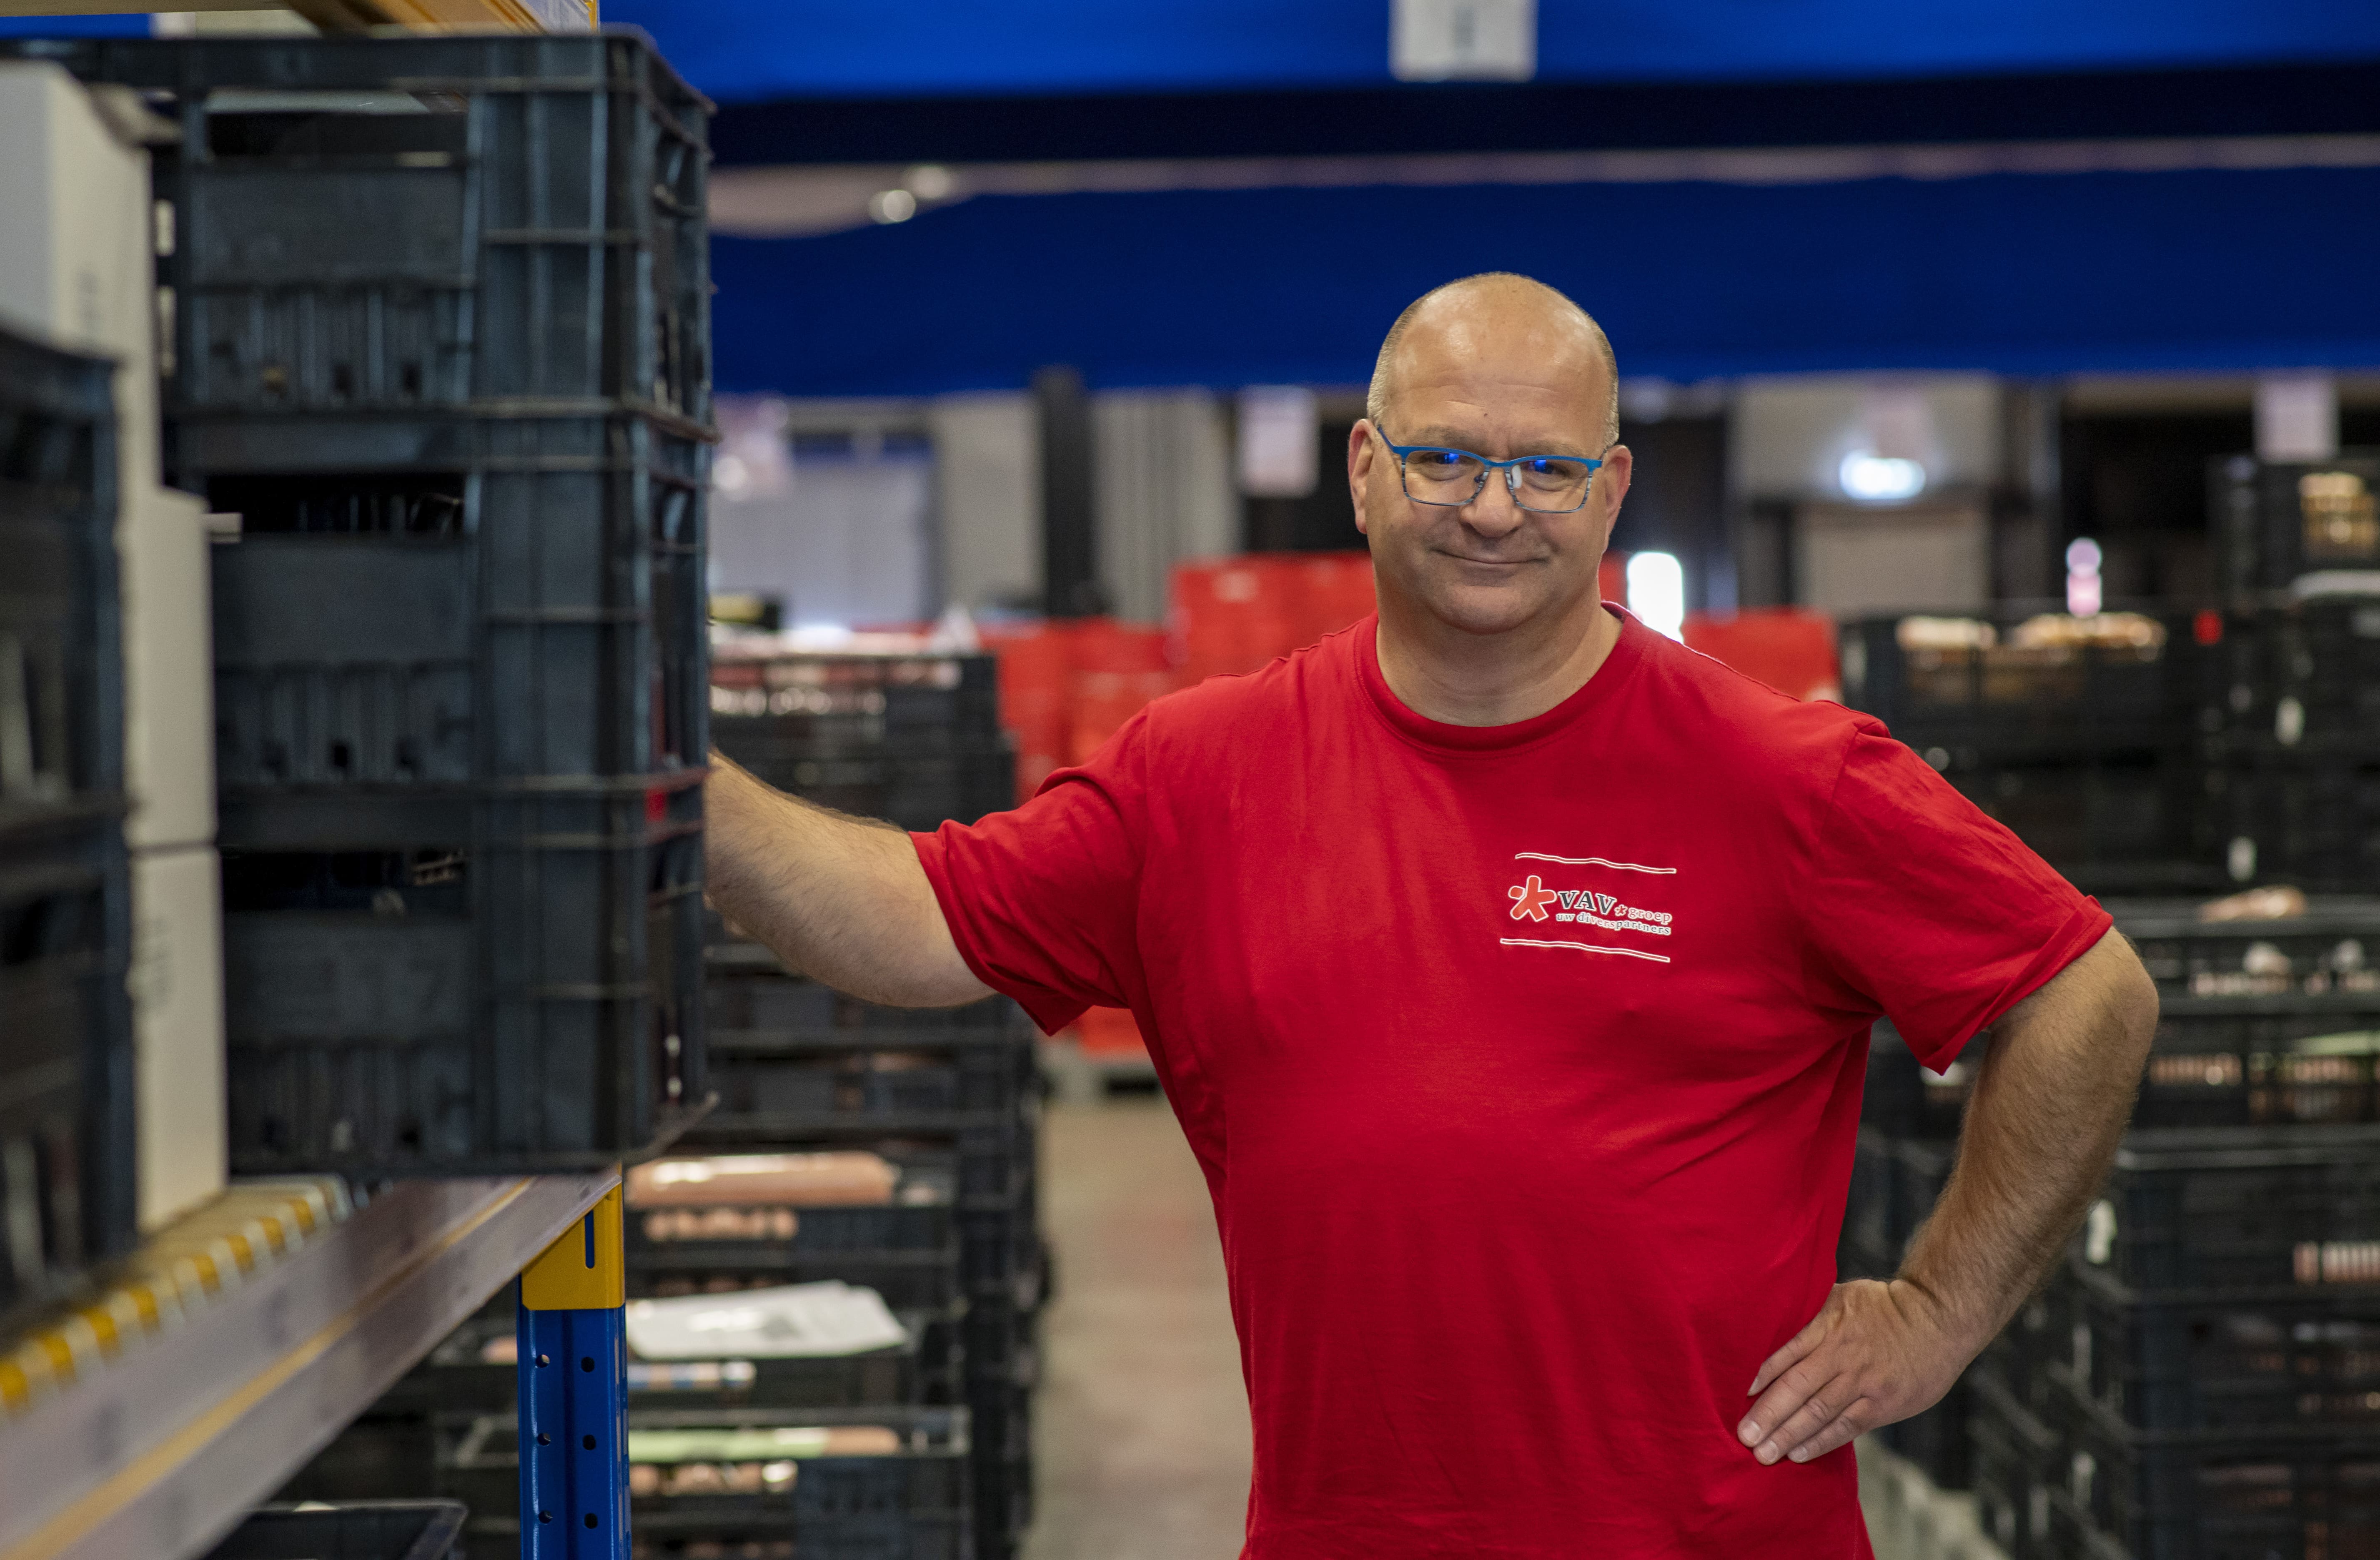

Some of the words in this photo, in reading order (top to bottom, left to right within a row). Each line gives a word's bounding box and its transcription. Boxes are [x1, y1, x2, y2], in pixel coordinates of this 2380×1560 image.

[1558, 891, 1616, 915] VAV
[1628, 907, 1672, 924] groep
[1556, 913, 1575, 922] uw
[1577, 912, 1671, 935] diverspartners
